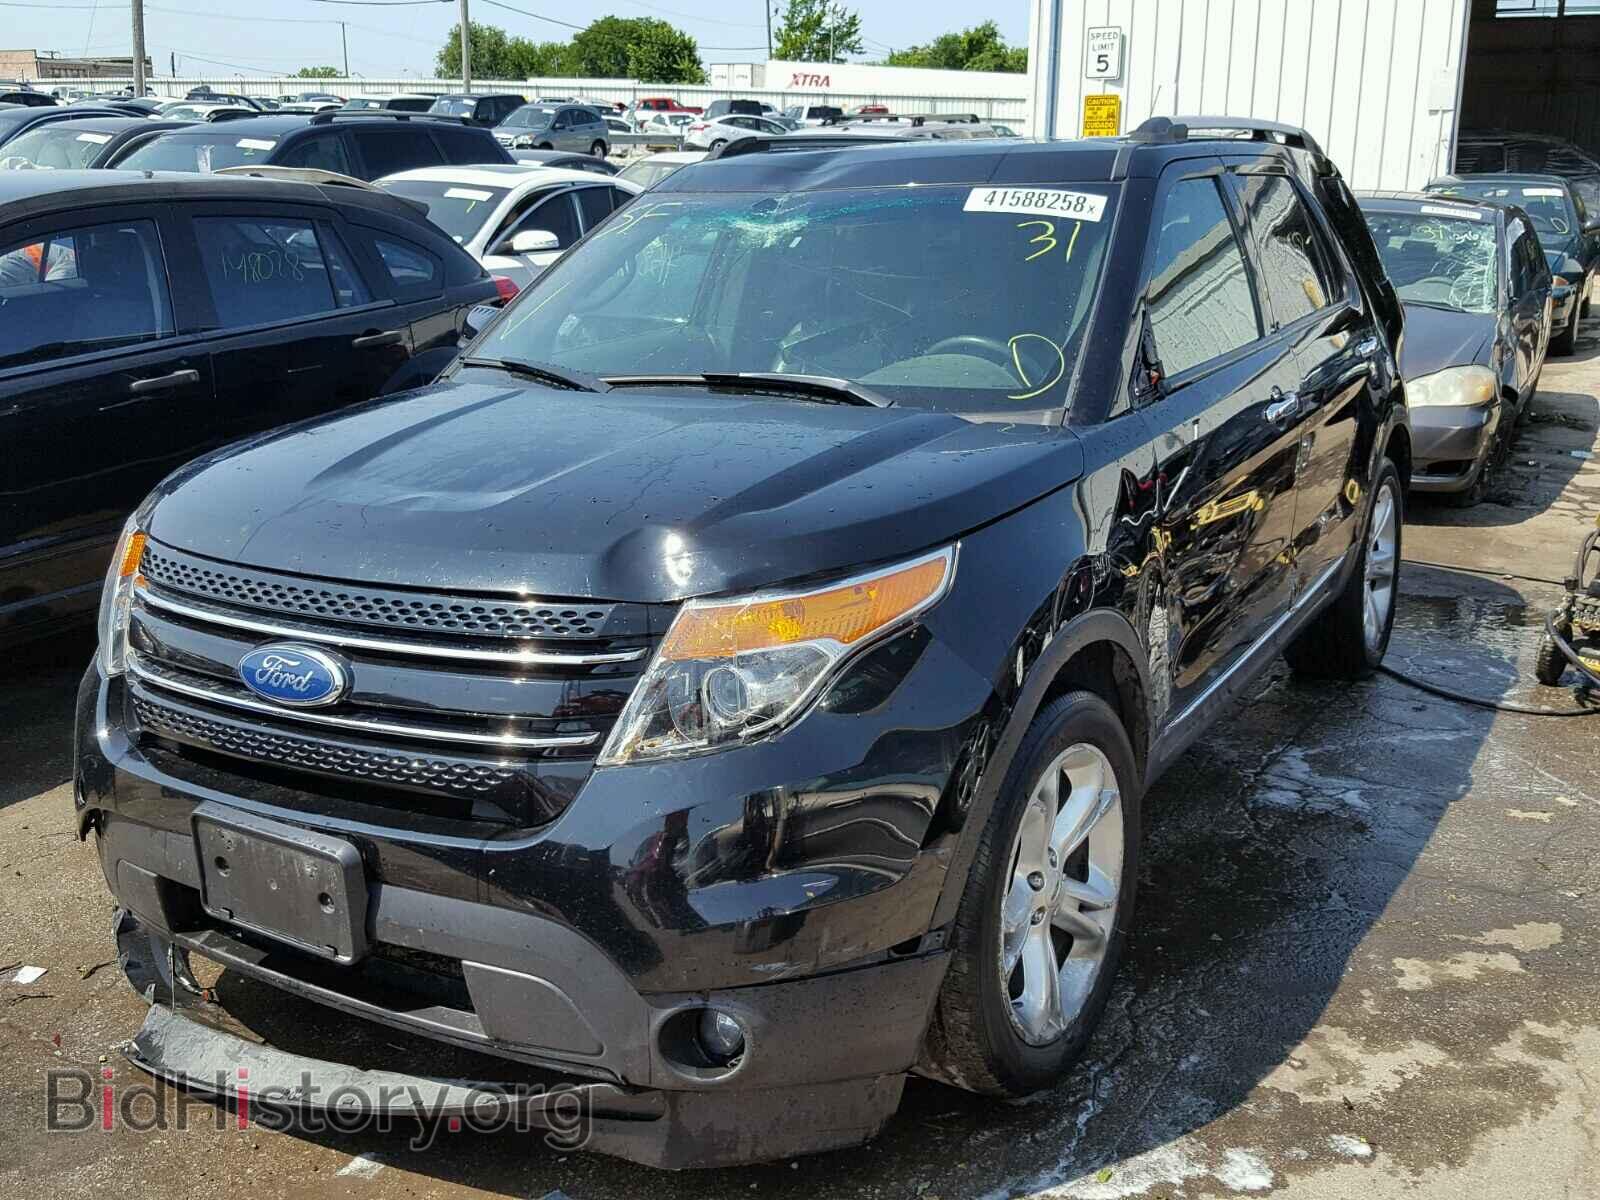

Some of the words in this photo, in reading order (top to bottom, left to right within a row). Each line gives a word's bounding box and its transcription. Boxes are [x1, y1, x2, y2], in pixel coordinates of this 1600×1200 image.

[1090, 32, 1119, 40] SPEED
[1091, 43, 1115, 51] LIMIT
[1096, 54, 1109, 72] 5
[788, 73, 830, 87] XTRA
[1016, 220, 1082, 264] 31
[255, 655, 313, 692] Ford
